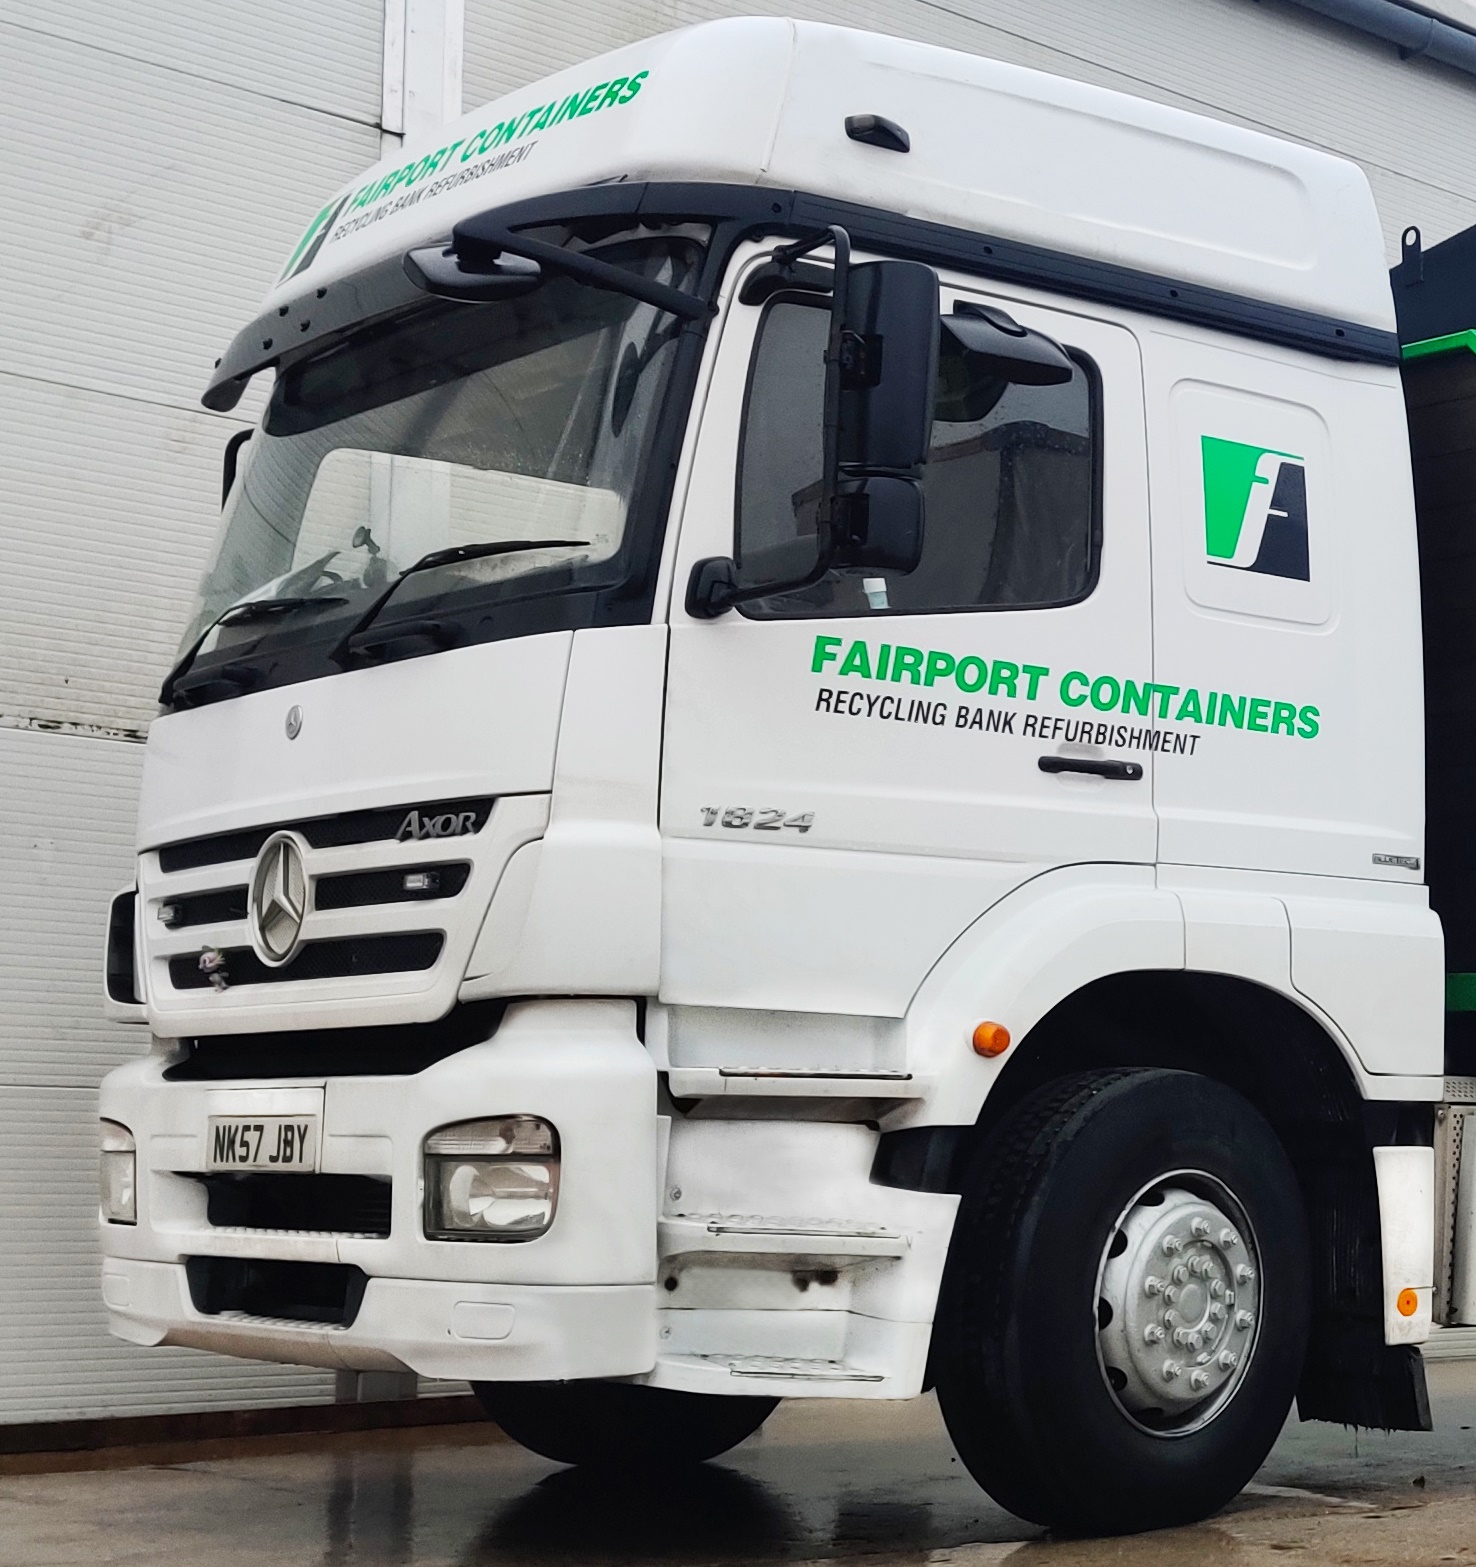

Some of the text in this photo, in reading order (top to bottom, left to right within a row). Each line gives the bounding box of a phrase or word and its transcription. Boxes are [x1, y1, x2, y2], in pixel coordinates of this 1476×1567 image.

[341, 70, 650, 217] FAIRPORT CONTAINERS
[330, 140, 538, 243] RECYCLING BANK REFURBISHMENT
[811, 635, 1320, 739] FAIRPORT CONTAINERS
[815, 688, 1201, 756] RECYCLING BANK REFURBISHMENT
[700, 806, 815, 833] 1824
[213, 1124, 308, 1163] NK57 JBY
